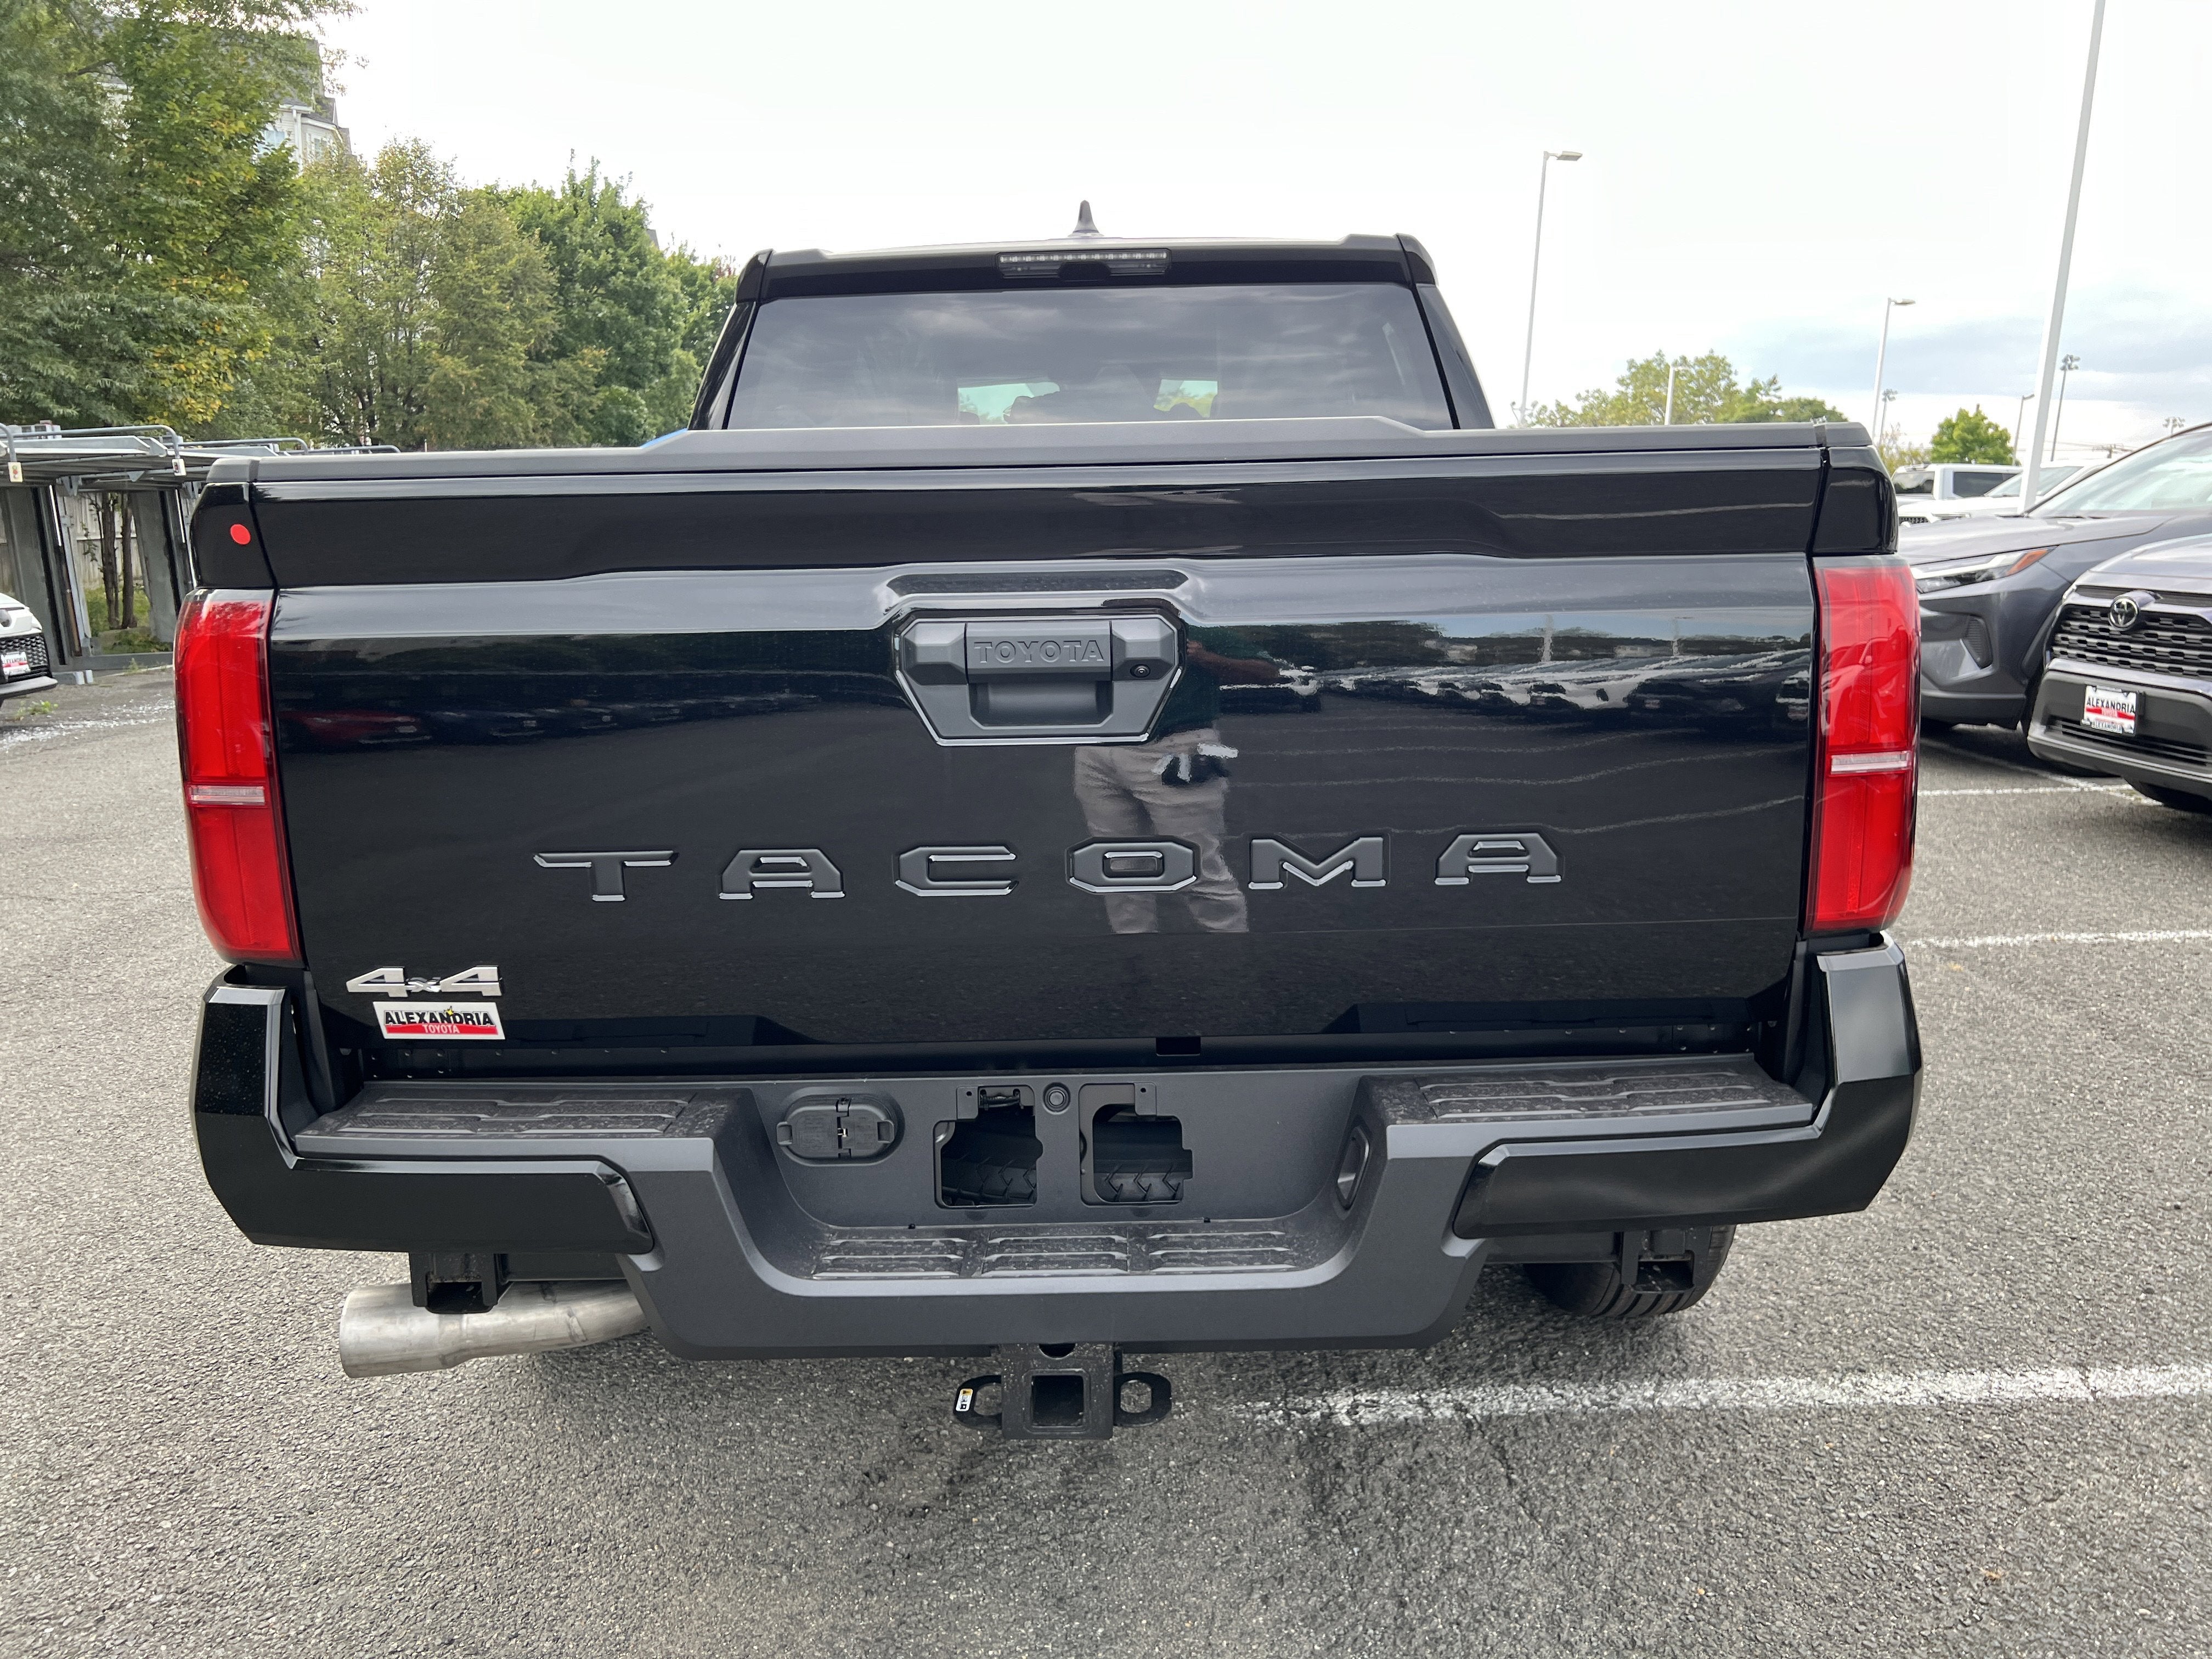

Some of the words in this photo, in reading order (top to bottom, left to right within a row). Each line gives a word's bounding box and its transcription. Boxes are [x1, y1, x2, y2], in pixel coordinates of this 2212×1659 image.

[973, 639, 1104, 664] TOYOTA
[2087, 697, 2136, 714] ALEXANDRIA
[533, 831, 1563, 901] TACOMA
[385, 1011, 494, 1025] ALEXANDRIA
[422, 1025, 460, 1034] TOYOTA
